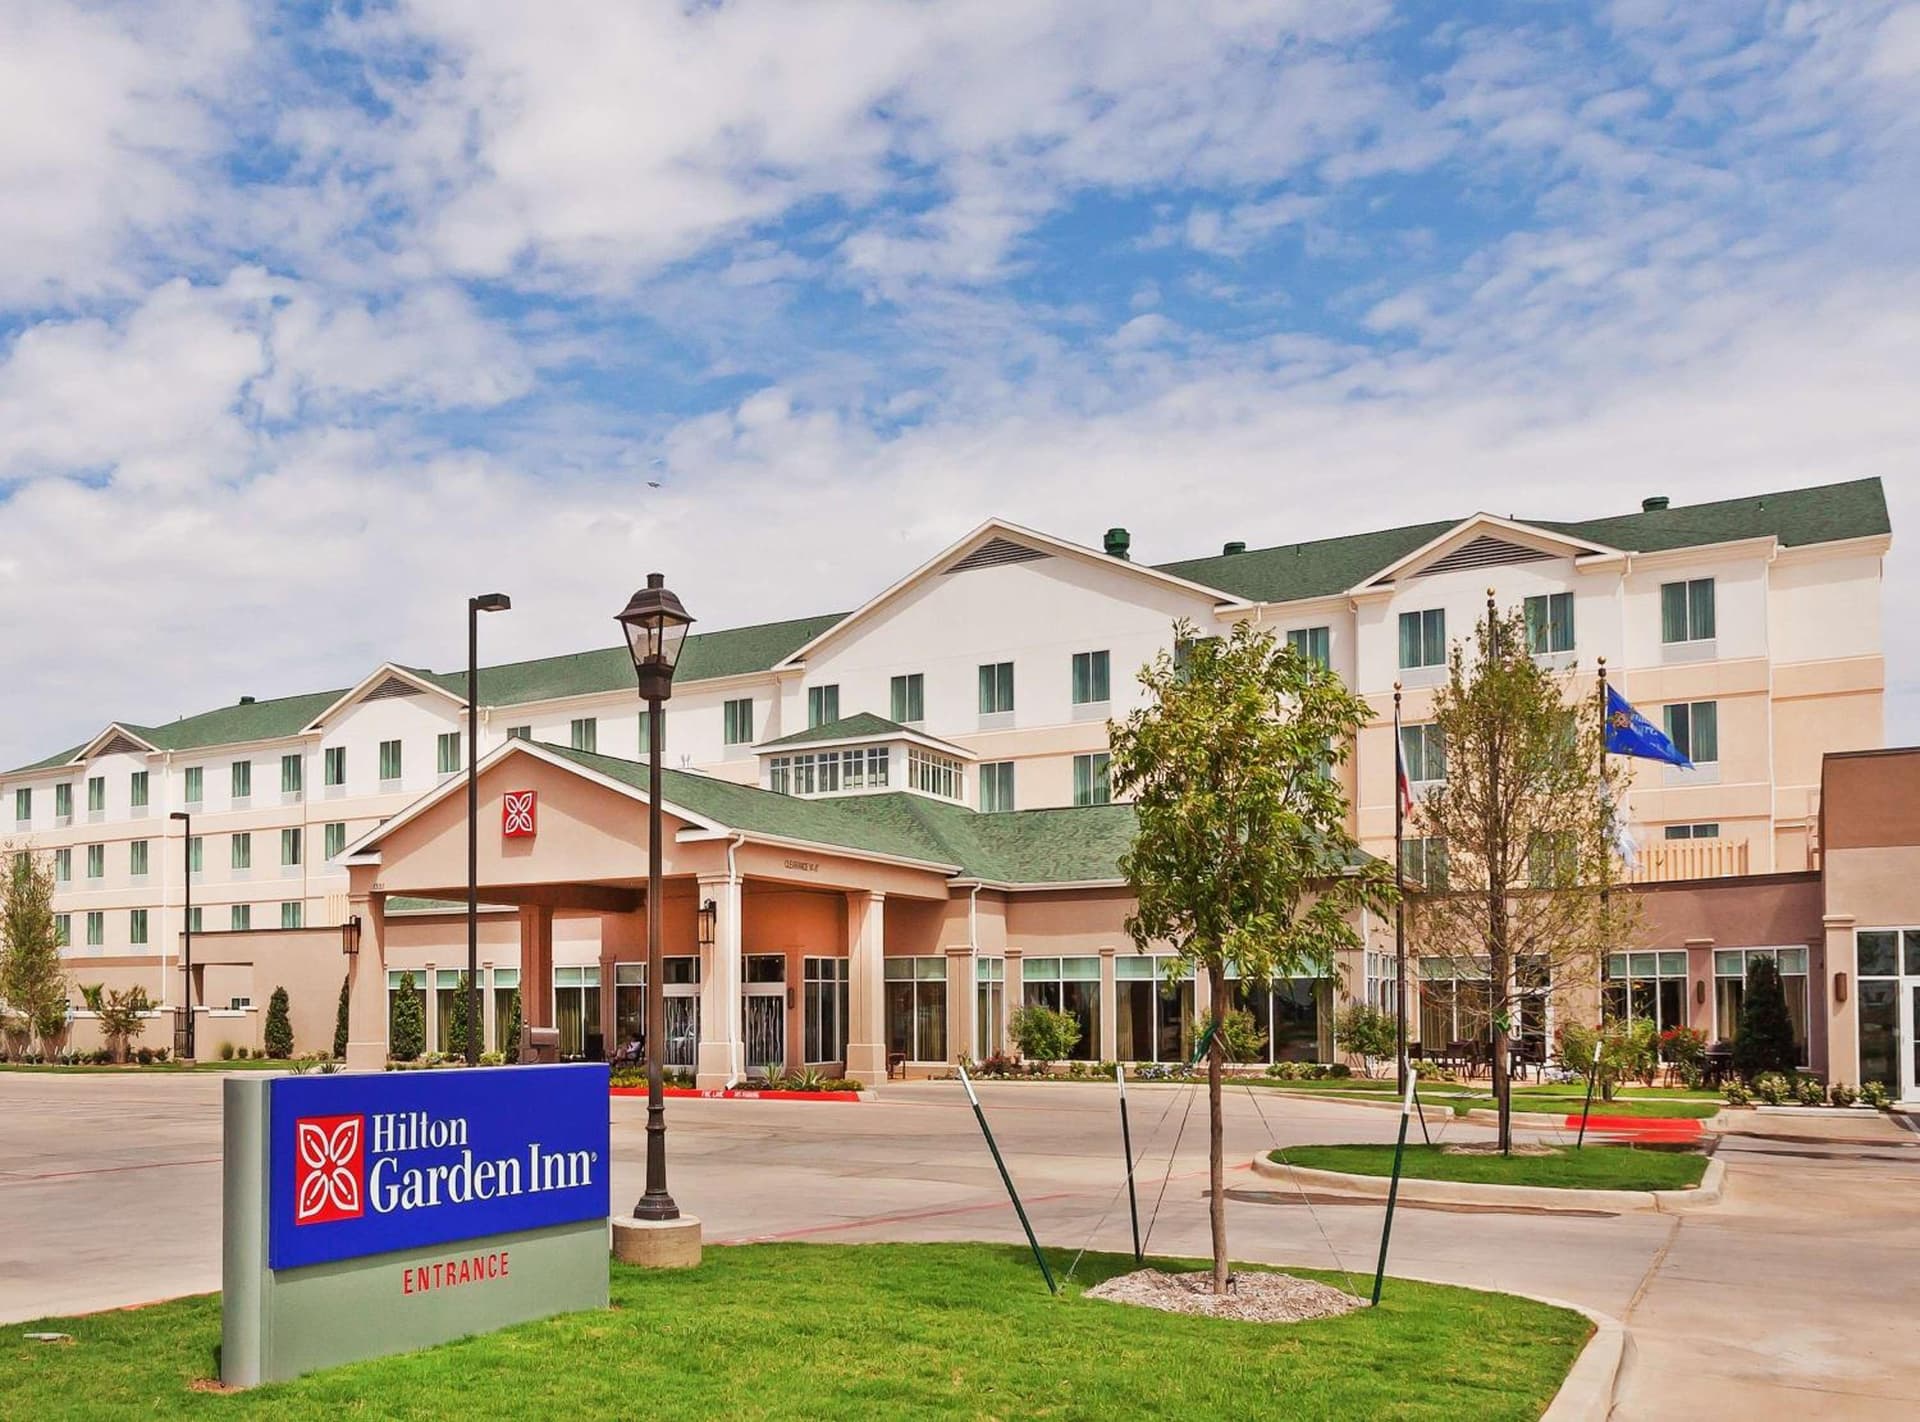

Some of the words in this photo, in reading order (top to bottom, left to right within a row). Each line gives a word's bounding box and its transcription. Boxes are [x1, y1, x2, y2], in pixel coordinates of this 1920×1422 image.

[371, 1111, 468, 1153] Hilton
[369, 1150, 523, 1213] Garden
[528, 1143, 592, 1193] Inn
[403, 1252, 510, 1295] ENTRANCE
